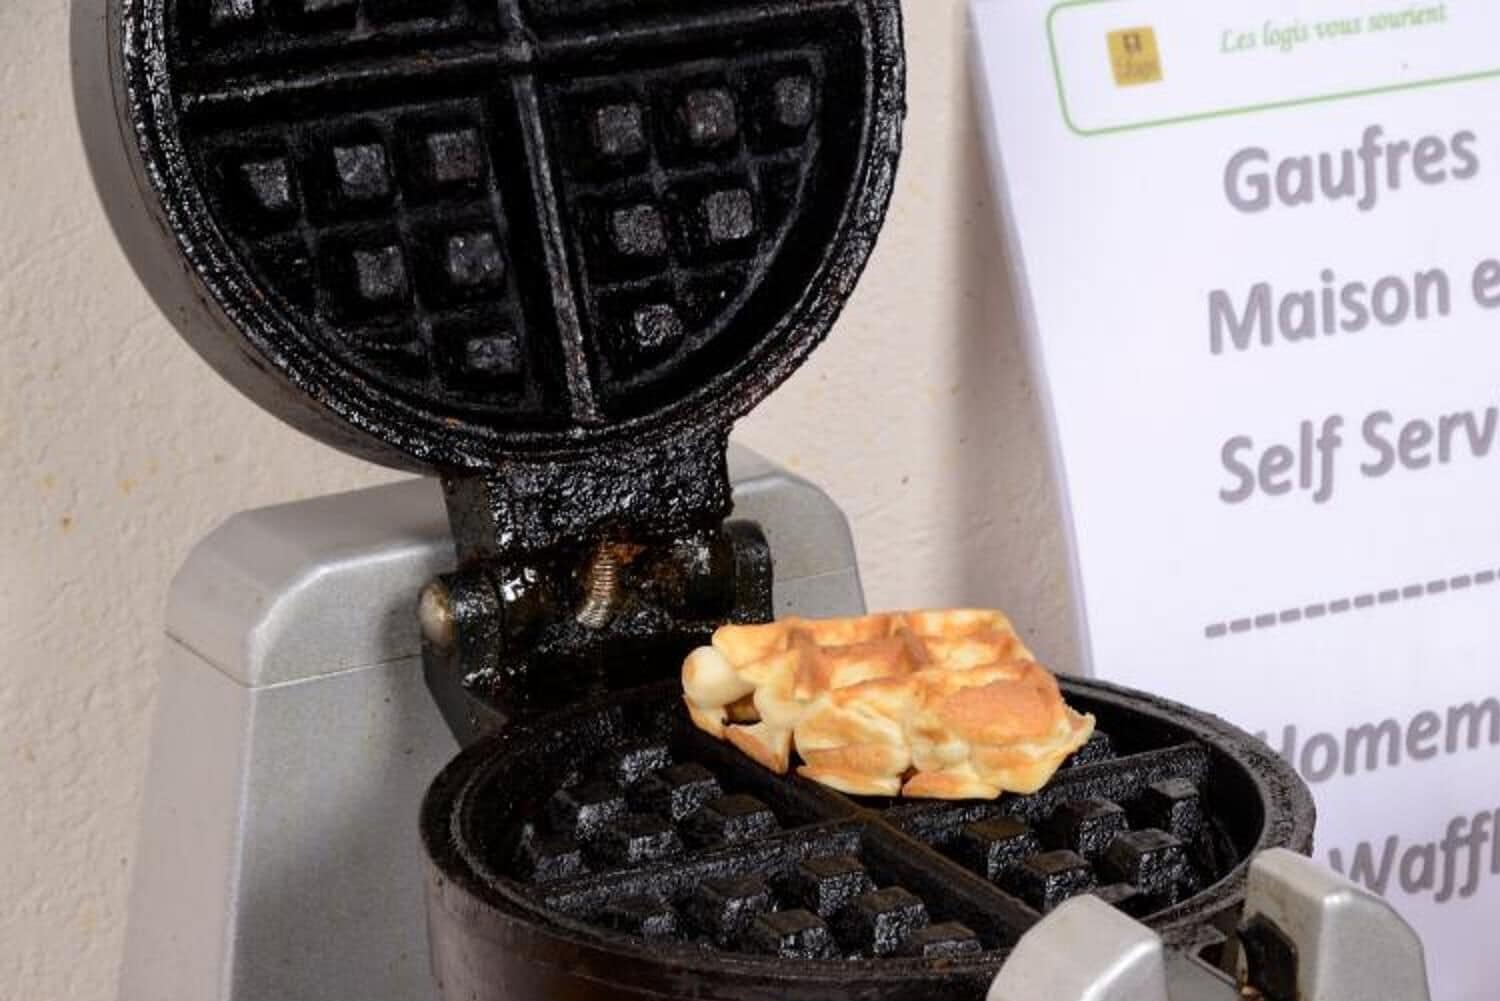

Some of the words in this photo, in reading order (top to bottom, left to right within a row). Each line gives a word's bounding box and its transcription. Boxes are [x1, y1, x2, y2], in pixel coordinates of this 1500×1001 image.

[1220, 29, 1256, 53] Les
[1261, 19, 1308, 52] logis
[1314, 16, 1361, 39] vous
[1224, 125, 1479, 213] Gaufres
[1208, 267, 1451, 355] Maison
[1219, 413, 1344, 504] Self
